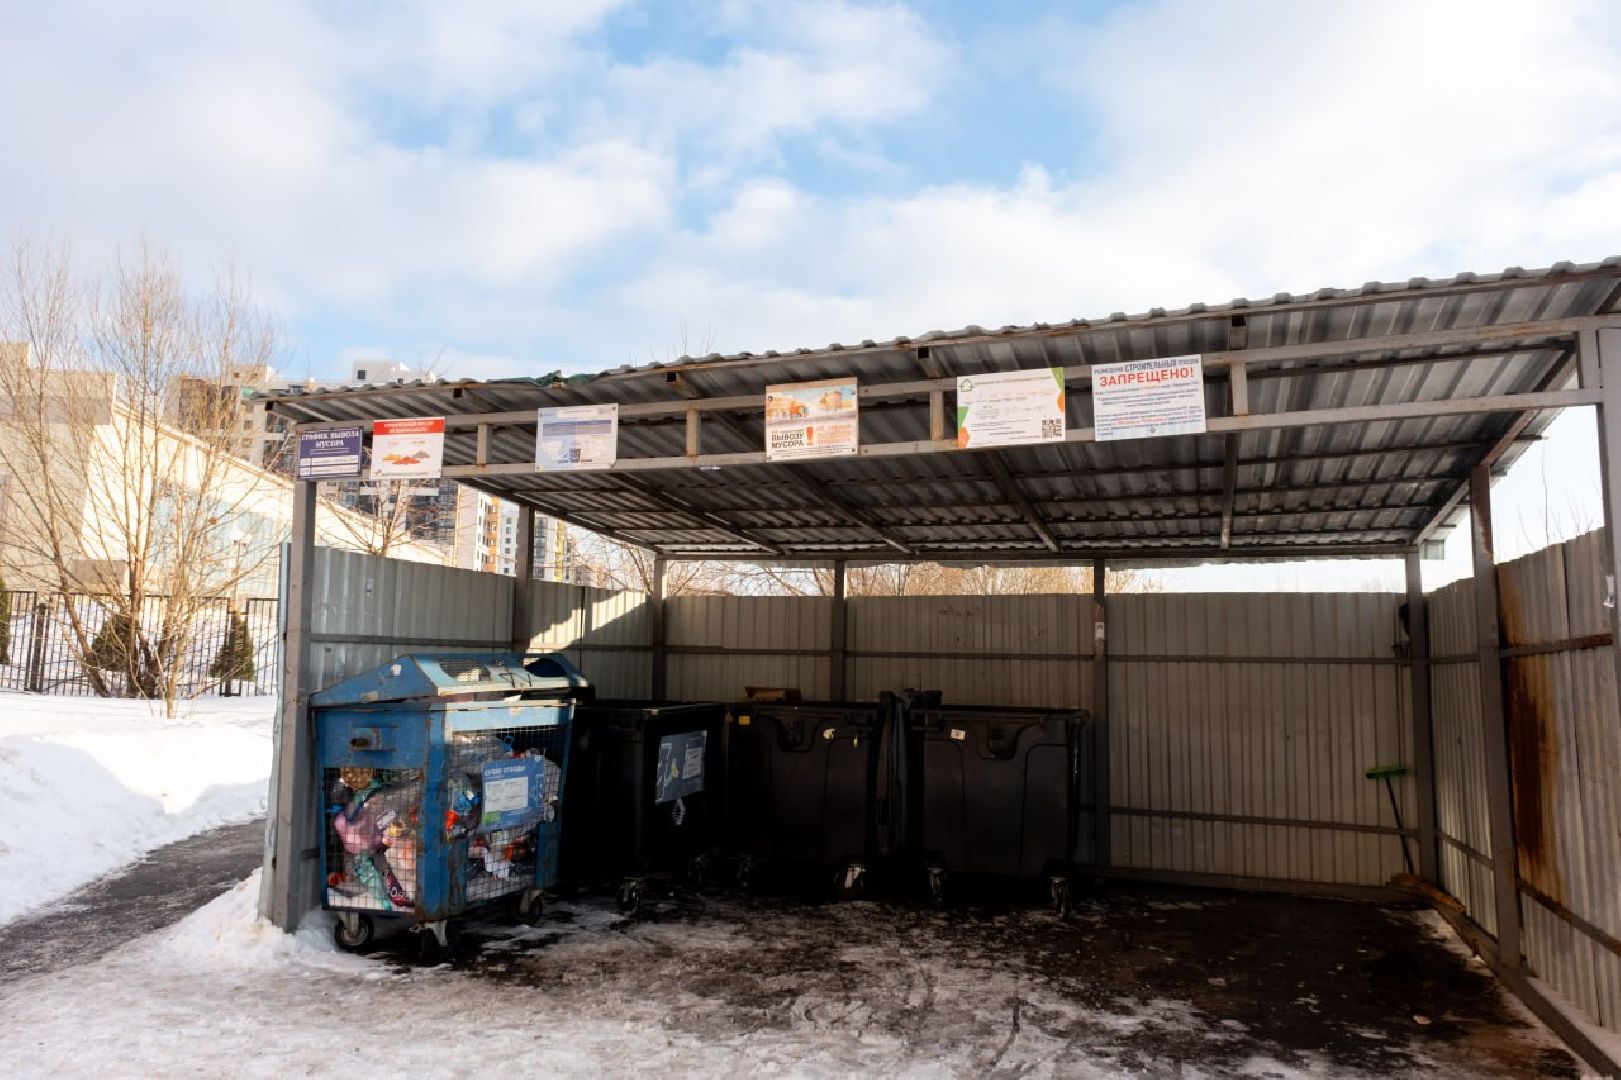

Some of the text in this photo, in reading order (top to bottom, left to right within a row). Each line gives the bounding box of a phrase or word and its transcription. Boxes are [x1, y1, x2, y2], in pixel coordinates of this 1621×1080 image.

[1099, 368, 1194, 387] ЗАПРЕЩЕНО!
[771, 432, 804, 441] ВЫВОЗУ
[771, 440, 804, 449] МУСОРА
